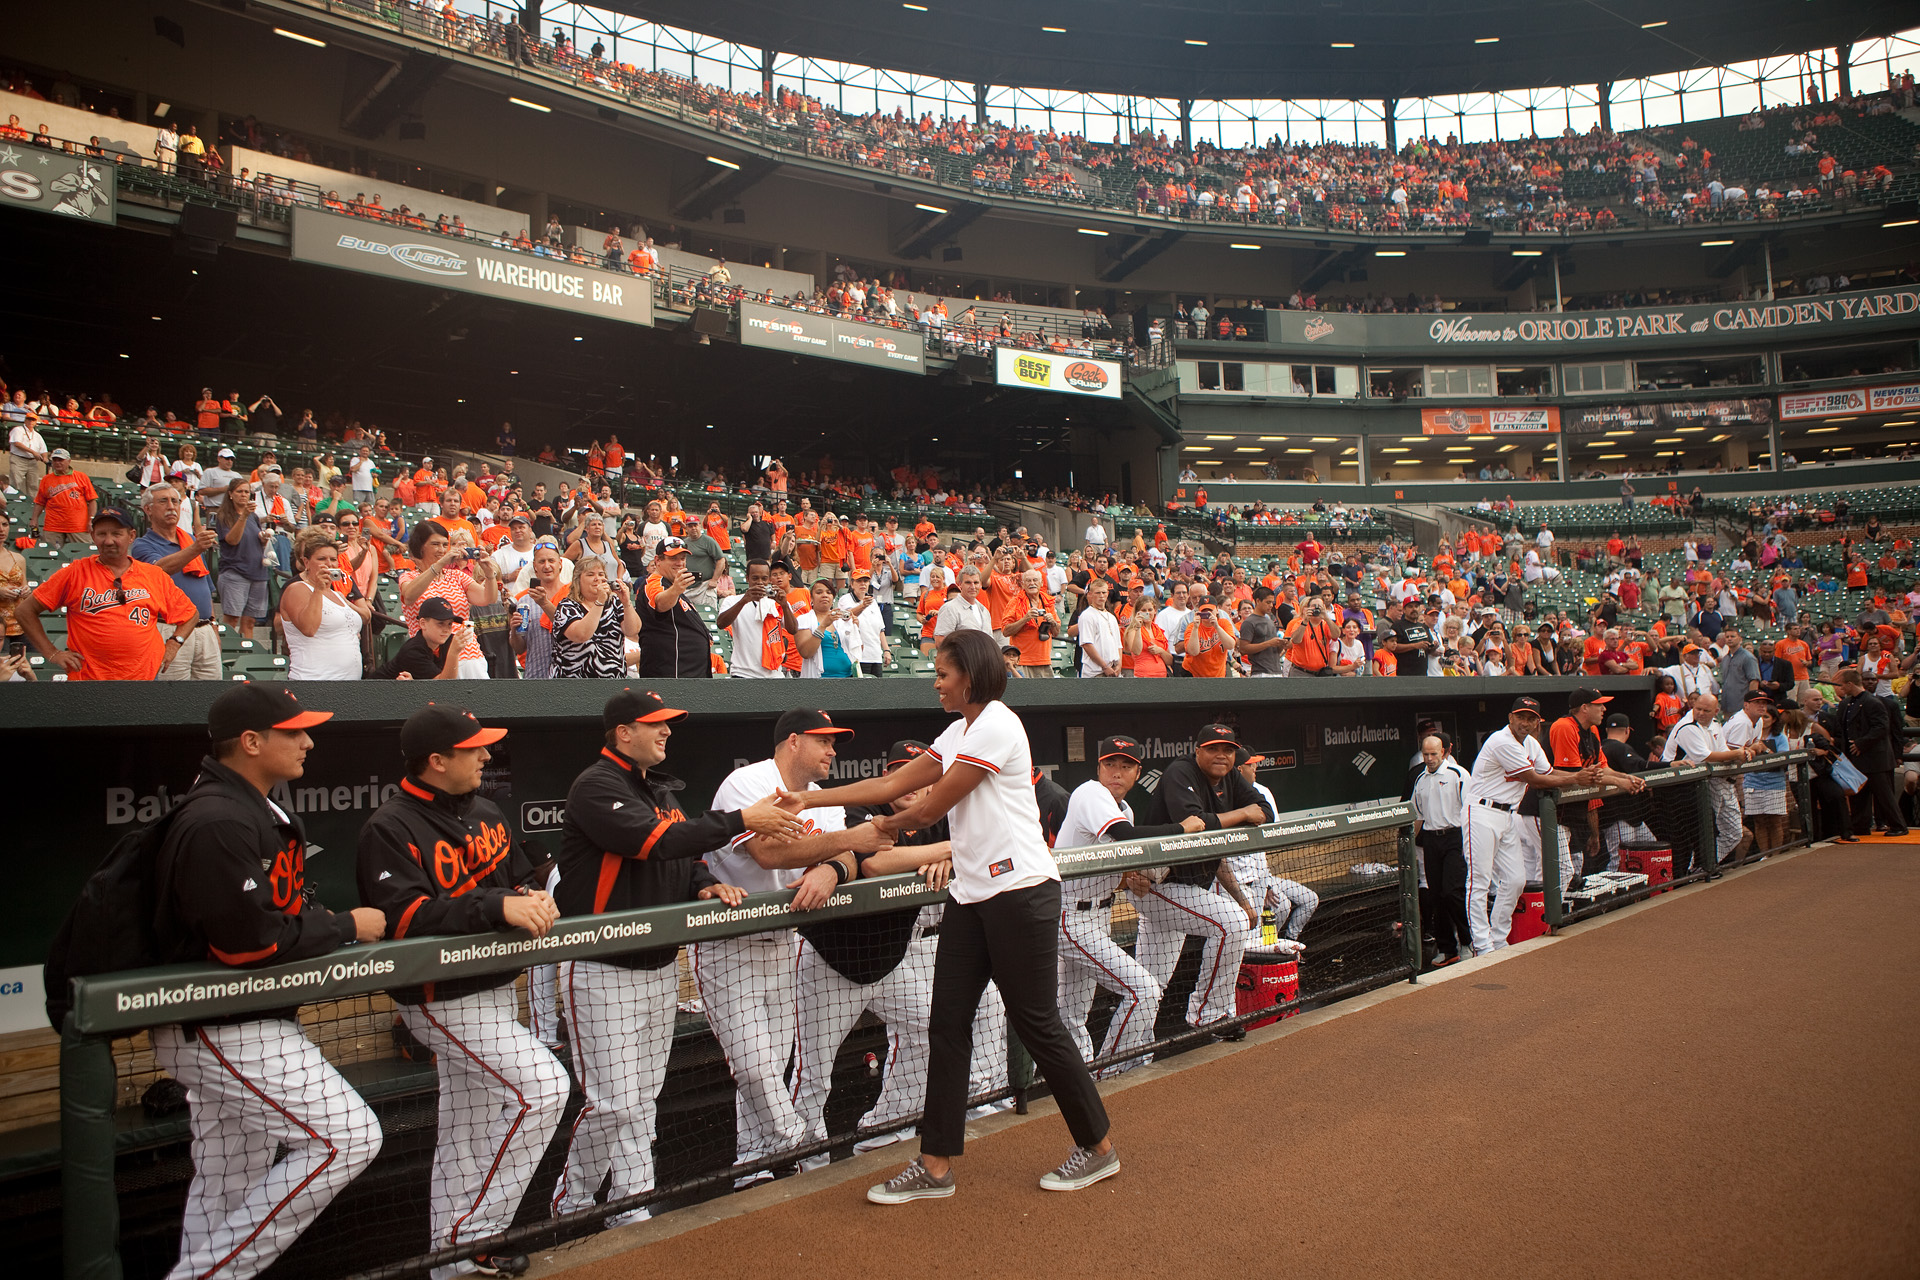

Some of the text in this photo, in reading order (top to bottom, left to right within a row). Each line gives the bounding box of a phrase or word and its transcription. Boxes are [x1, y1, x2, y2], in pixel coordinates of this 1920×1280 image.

[337, 235, 467, 270] BUD LIGHT
[476, 257, 623, 306] WAREHOUSE BAR
[1429, 292, 1920, 343] Welcome to ORIOLE PARK at CAMDEN YARD
[793, 335, 828, 346] EVERY GAME
[887, 351, 919, 362] EVERY GAME
[1019, 358, 1050, 373] BEST
[1020, 369, 1047, 381] BUY
[1071, 362, 1101, 383] Geek
[1785, 395, 1849, 410] ESPN 980
[1873, 396, 1904, 407] 910
[1492, 412, 1528, 423] 105.7
[129, 607, 150, 626] 49
[1324, 723, 1400, 746] Bank of America
[1261, 819, 1337, 839] bankofamerica.com/Orioles
[1160, 832, 1249, 852] bankofamerica.com/Orioles
[440, 920, 652, 966] bankofamerica.com/Orioles
[117, 957, 396, 1013] bankofamerica.com/Orioles
